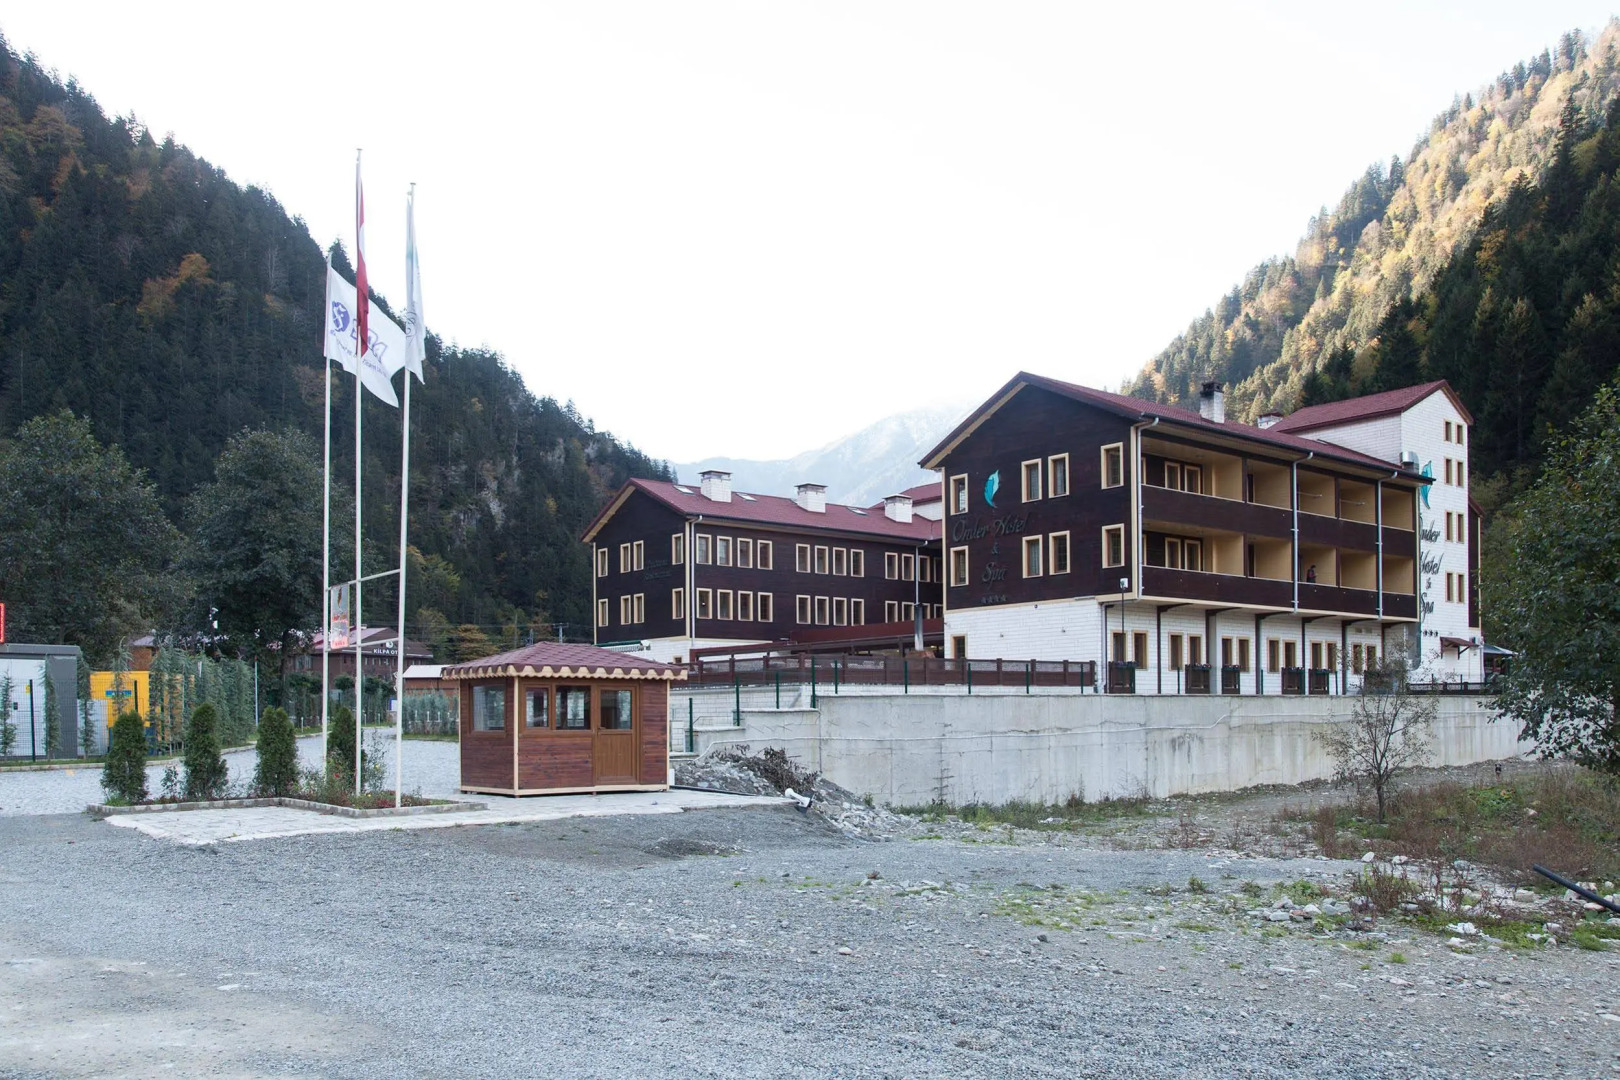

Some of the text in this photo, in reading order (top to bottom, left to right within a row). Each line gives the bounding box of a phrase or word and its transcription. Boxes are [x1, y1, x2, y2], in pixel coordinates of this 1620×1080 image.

[992, 512, 1028, 537] Hotel
[991, 542, 1000, 554] &
[982, 561, 1008, 589] Spa
[1420, 592, 1434, 623] Spa
